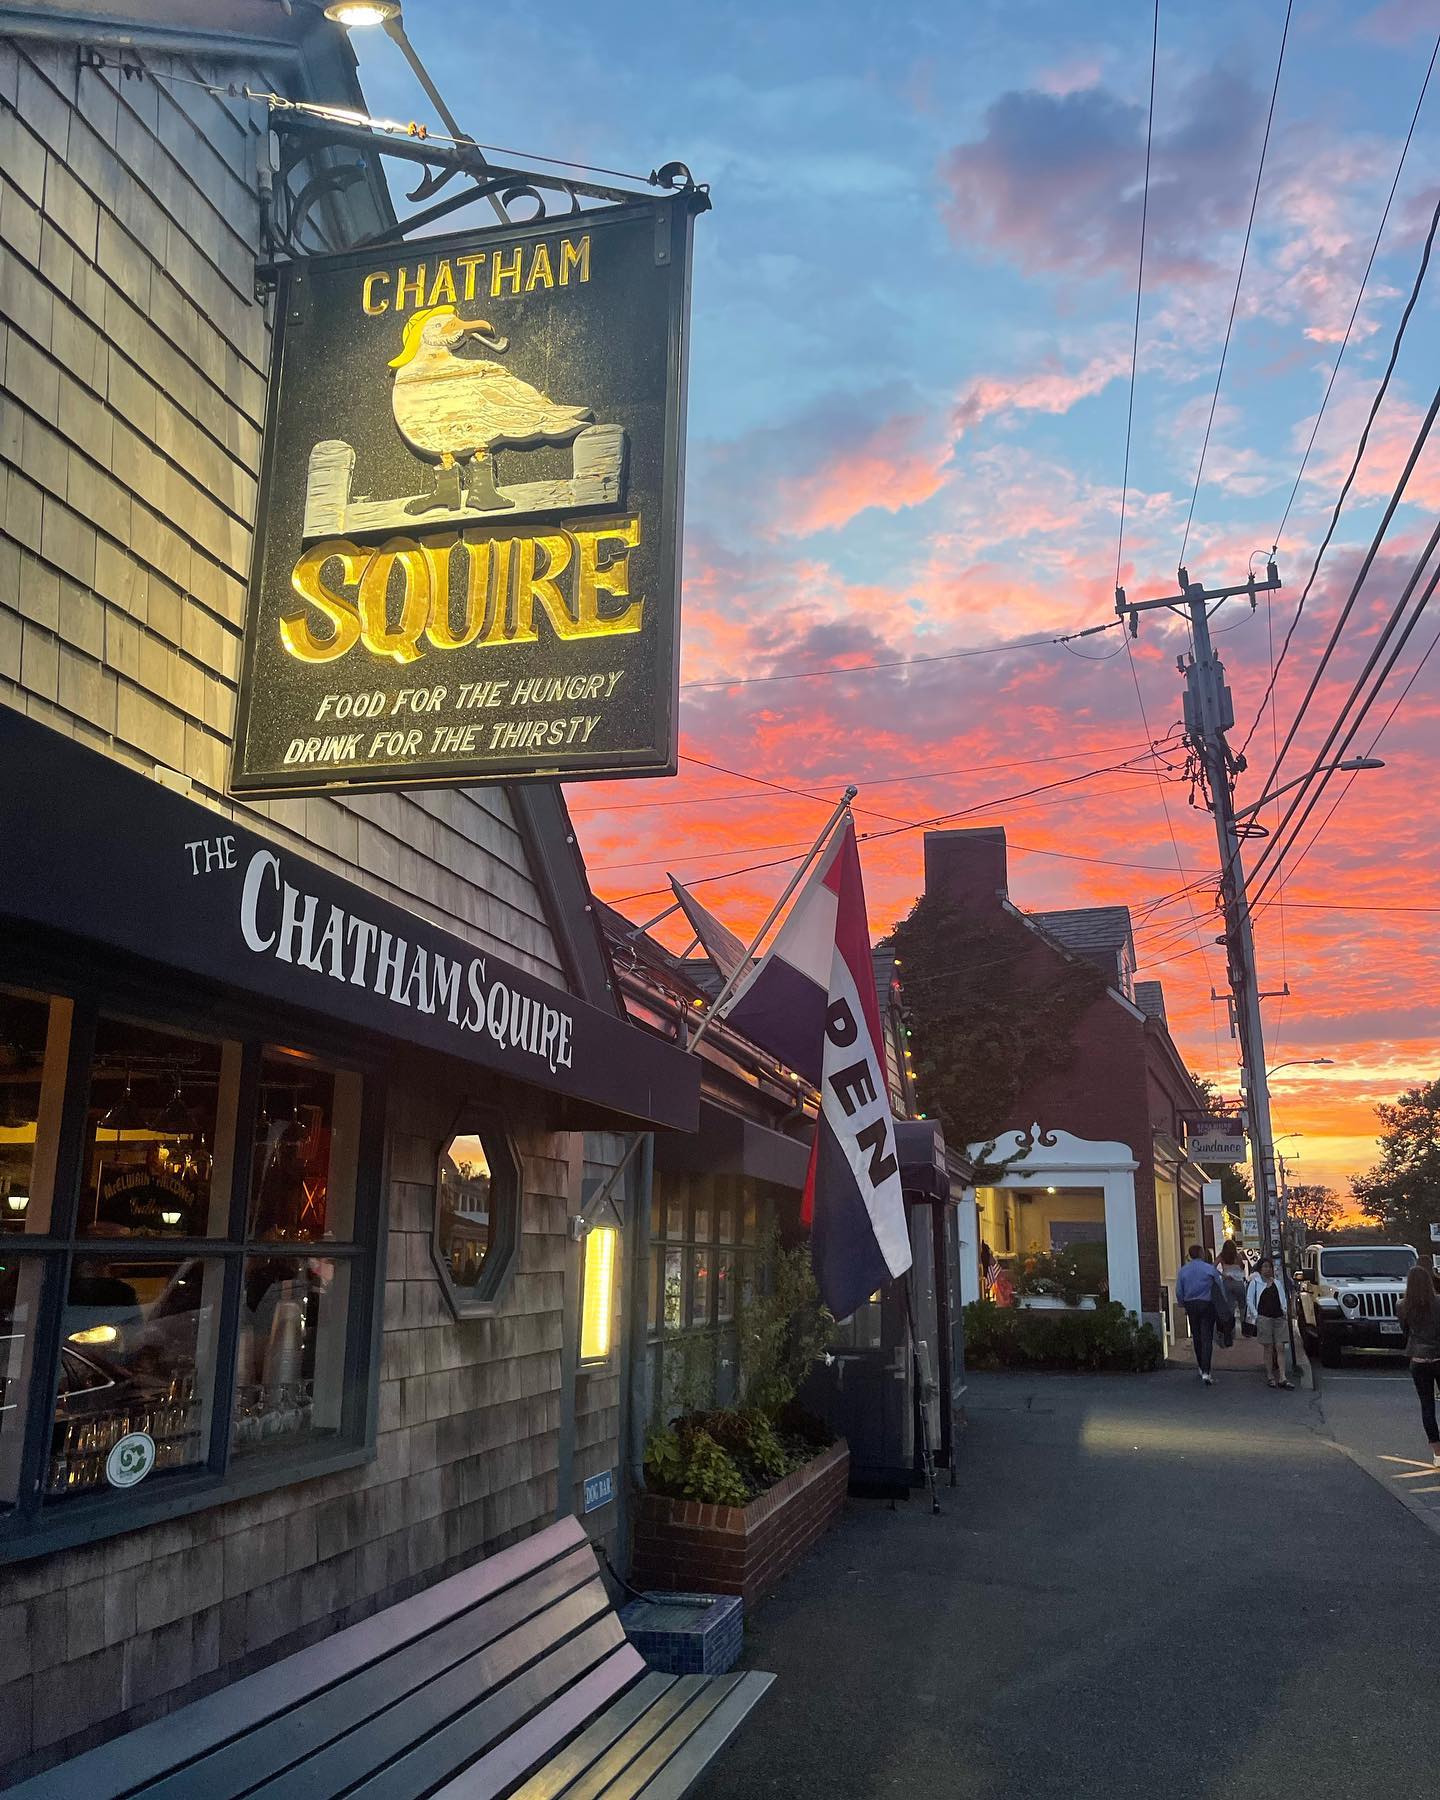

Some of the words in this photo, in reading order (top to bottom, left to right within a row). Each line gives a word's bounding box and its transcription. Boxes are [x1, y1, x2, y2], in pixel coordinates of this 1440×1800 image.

[362, 235, 591, 316] CHATHAM
[280, 512, 646, 664] SQUIRE
[315, 690, 387, 721] FOOD
[391, 685, 448, 715] FOR
[455, 680, 510, 709] THE
[510, 670, 625, 705] HUNGRY
[283, 733, 365, 763] DRINK
[367, 729, 424, 758] FOR
[430, 724, 484, 753] THE
[489, 715, 602, 749] THIRSTY
[184, 835, 238, 876] THE
[240, 849, 463, 1026] CHATHAM
[460, 957, 573, 1074] SQUIRE
[824, 997, 898, 1189] PEN
[1191, 1139, 1241, 1153] Sundance
